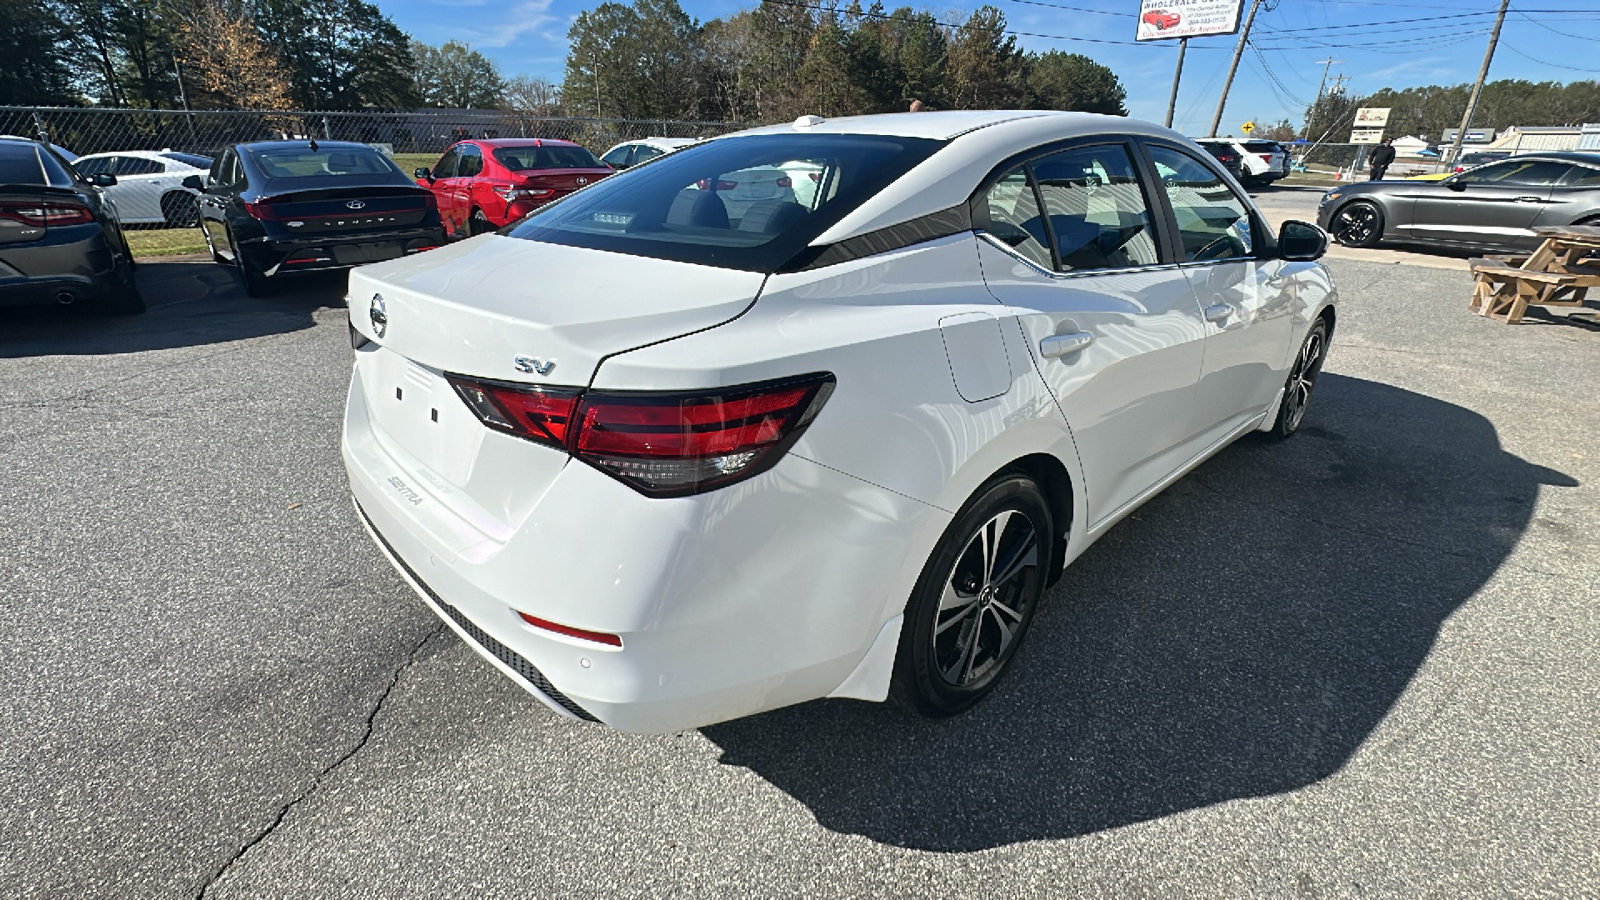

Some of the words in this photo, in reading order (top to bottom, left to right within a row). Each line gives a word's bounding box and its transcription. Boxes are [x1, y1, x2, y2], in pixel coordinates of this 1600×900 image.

[1144, 0, 1197, 9] WHOLESALE
[325, 217, 395, 226] SONATA
[515, 356, 557, 377] SV
[387, 476, 423, 506] SENTRA
